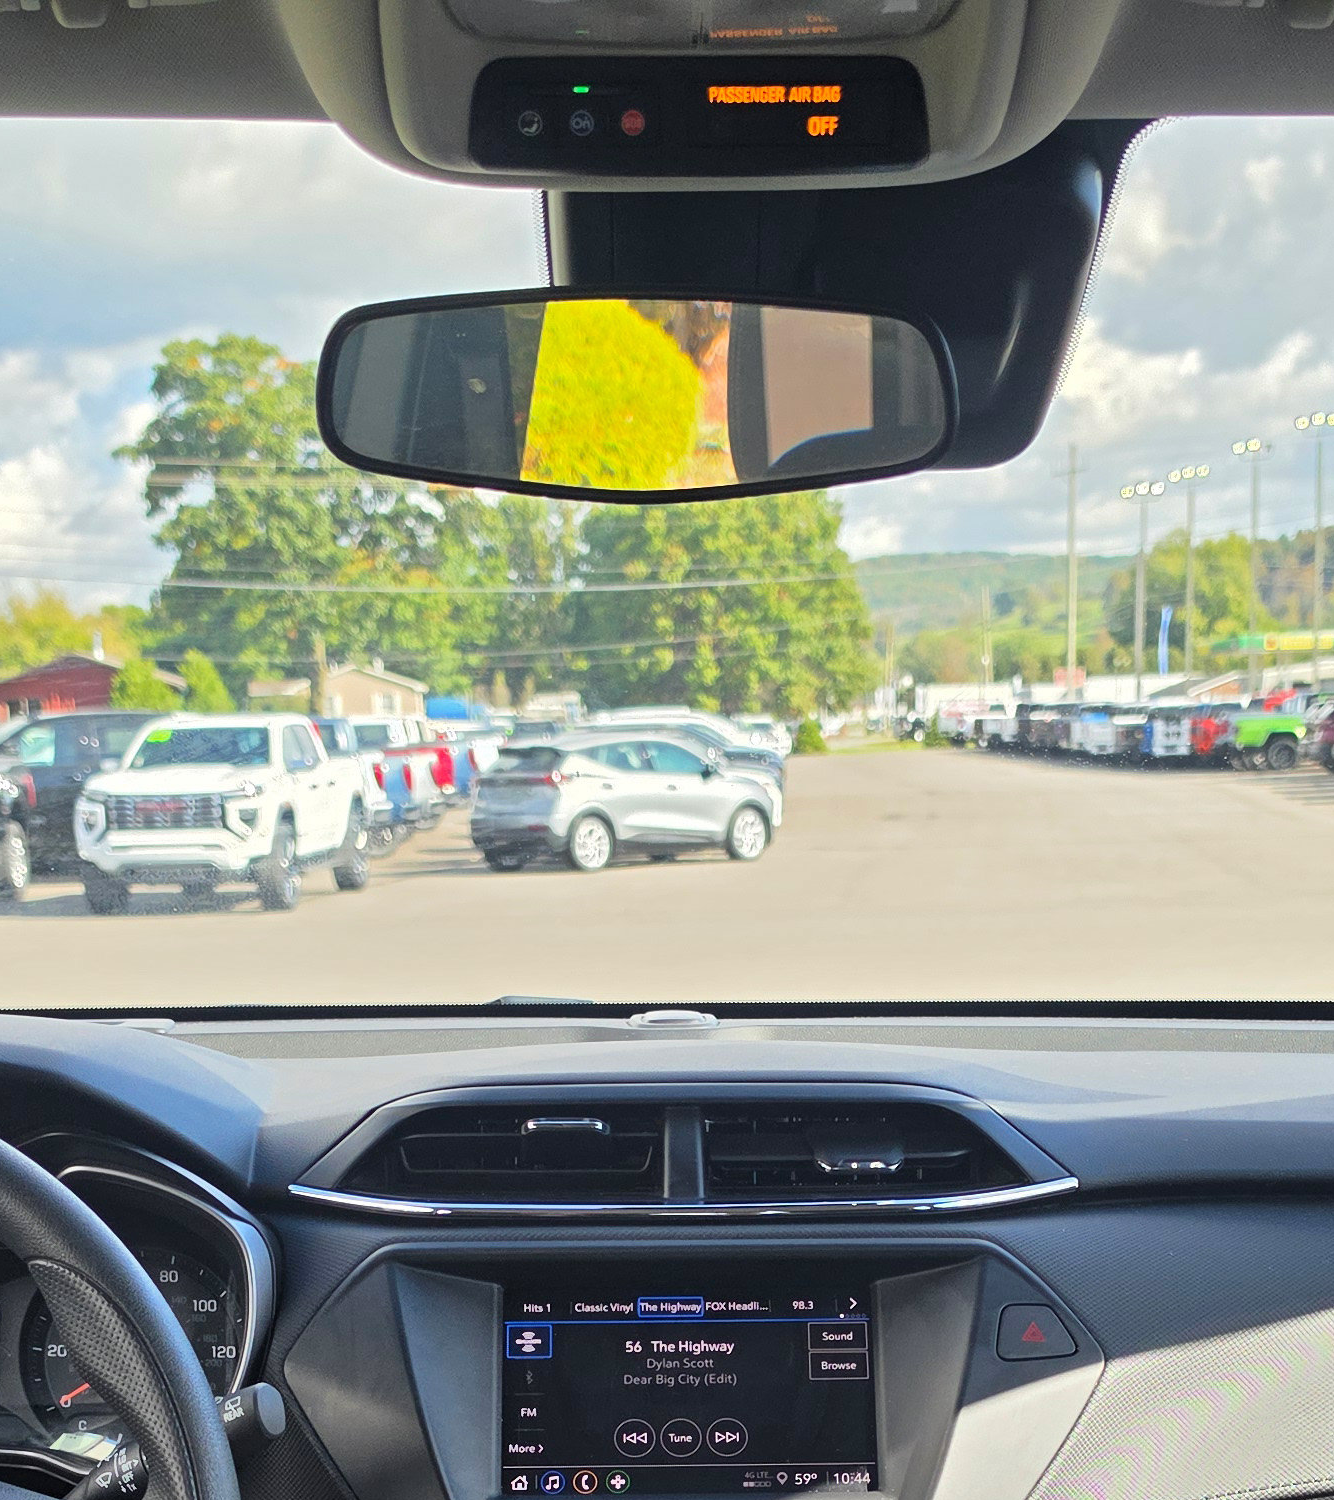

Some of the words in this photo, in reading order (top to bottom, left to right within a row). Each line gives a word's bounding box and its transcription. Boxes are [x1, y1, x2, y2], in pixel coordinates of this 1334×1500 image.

[709, 86, 786, 103] PASSENGER
[788, 86, 811, 103] AIR
[812, 86, 841, 103] BAG
[807, 116, 839, 136] OFF
[159, 1270, 179, 1284] 80
[192, 1300, 217, 1312] 100
[523, 1303, 544, 1313] Hits
[546, 1303, 552, 1313] 1
[574, 1303, 609, 1313] Classic
[610, 1303, 634, 1314] Vinyl
[639, 1302, 658, 1312] The
[660, 1302, 702, 1314] Highway
[705, 1301, 727, 1311] FOX
[792, 1301, 814, 1310] 98.3
[822, 1331, 854, 1341] Sound
[47, 1344, 67, 1357] 20
[211, 1345, 237, 1359] 120
[625, 1341, 643, 1353] 56
[651, 1340, 676, 1352] The
[678, 1340, 735, 1355] Highway
[646, 1358, 681, 1371] Dylan
[682, 1358, 714, 1368] Scott
[821, 1360, 857, 1371] Browse
[623, 1375, 653, 1385] Dear
[655, 1374, 675, 1387] Big
[677, 1374, 702, 1387] City
[704, 1373, 738, 1387] (Edit)
[222, 1408, 245, 1423] REAR
[520, 1407, 538, 1418] FM
[78, 1420, 87, 1431] C
[668, 1433, 693, 1443] Tune
[508, 1443, 536, 1453] More
[744, 1471, 755, 1479] 4G
[833, 1472, 871, 1485] 10:44
